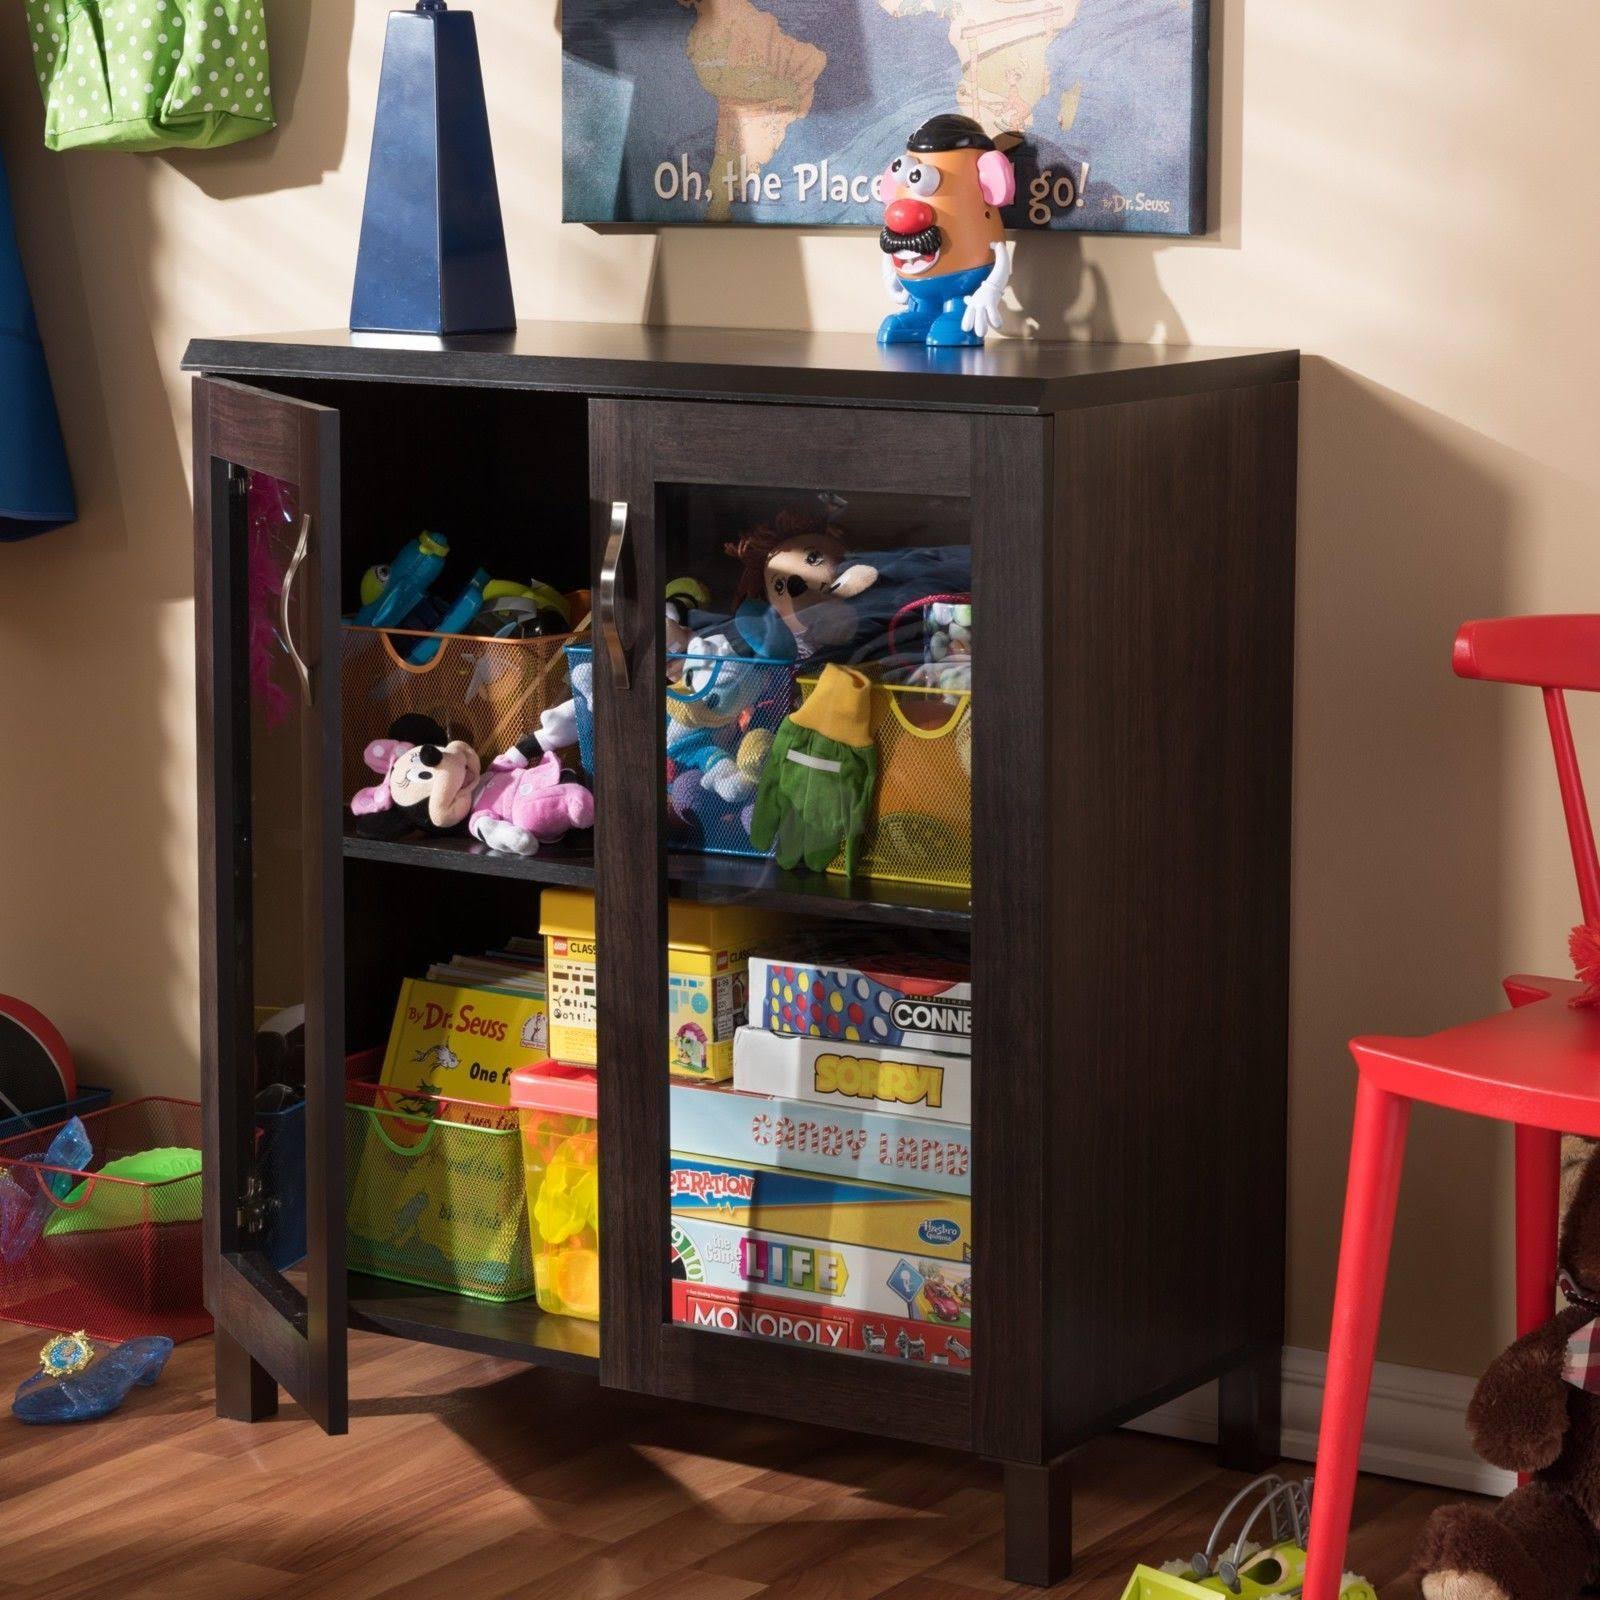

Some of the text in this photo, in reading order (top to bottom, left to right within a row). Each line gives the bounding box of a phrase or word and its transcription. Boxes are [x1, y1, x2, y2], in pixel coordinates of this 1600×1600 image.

[655, 153, 713, 202] Oh,
[722, 154, 782, 203] the
[1029, 162, 1090, 225] go!
[1112, 194, 1134, 213] Dr.
[1134, 192, 1171, 213] Seuss
[408, 1007, 424, 1024] By
[423, 1002, 453, 1031] Dr.
[456, 1004, 508, 1042] Seuss
[894, 1003, 972, 1034] CONNE
[470, 1061, 498, 1083] One
[752, 1113, 970, 1177] CANDY LAND
[924, 1220, 957, 1236] Hasbro
[745, 1241, 838, 1292] LIFE
[693, 1302, 844, 1348] MONOPOLY
